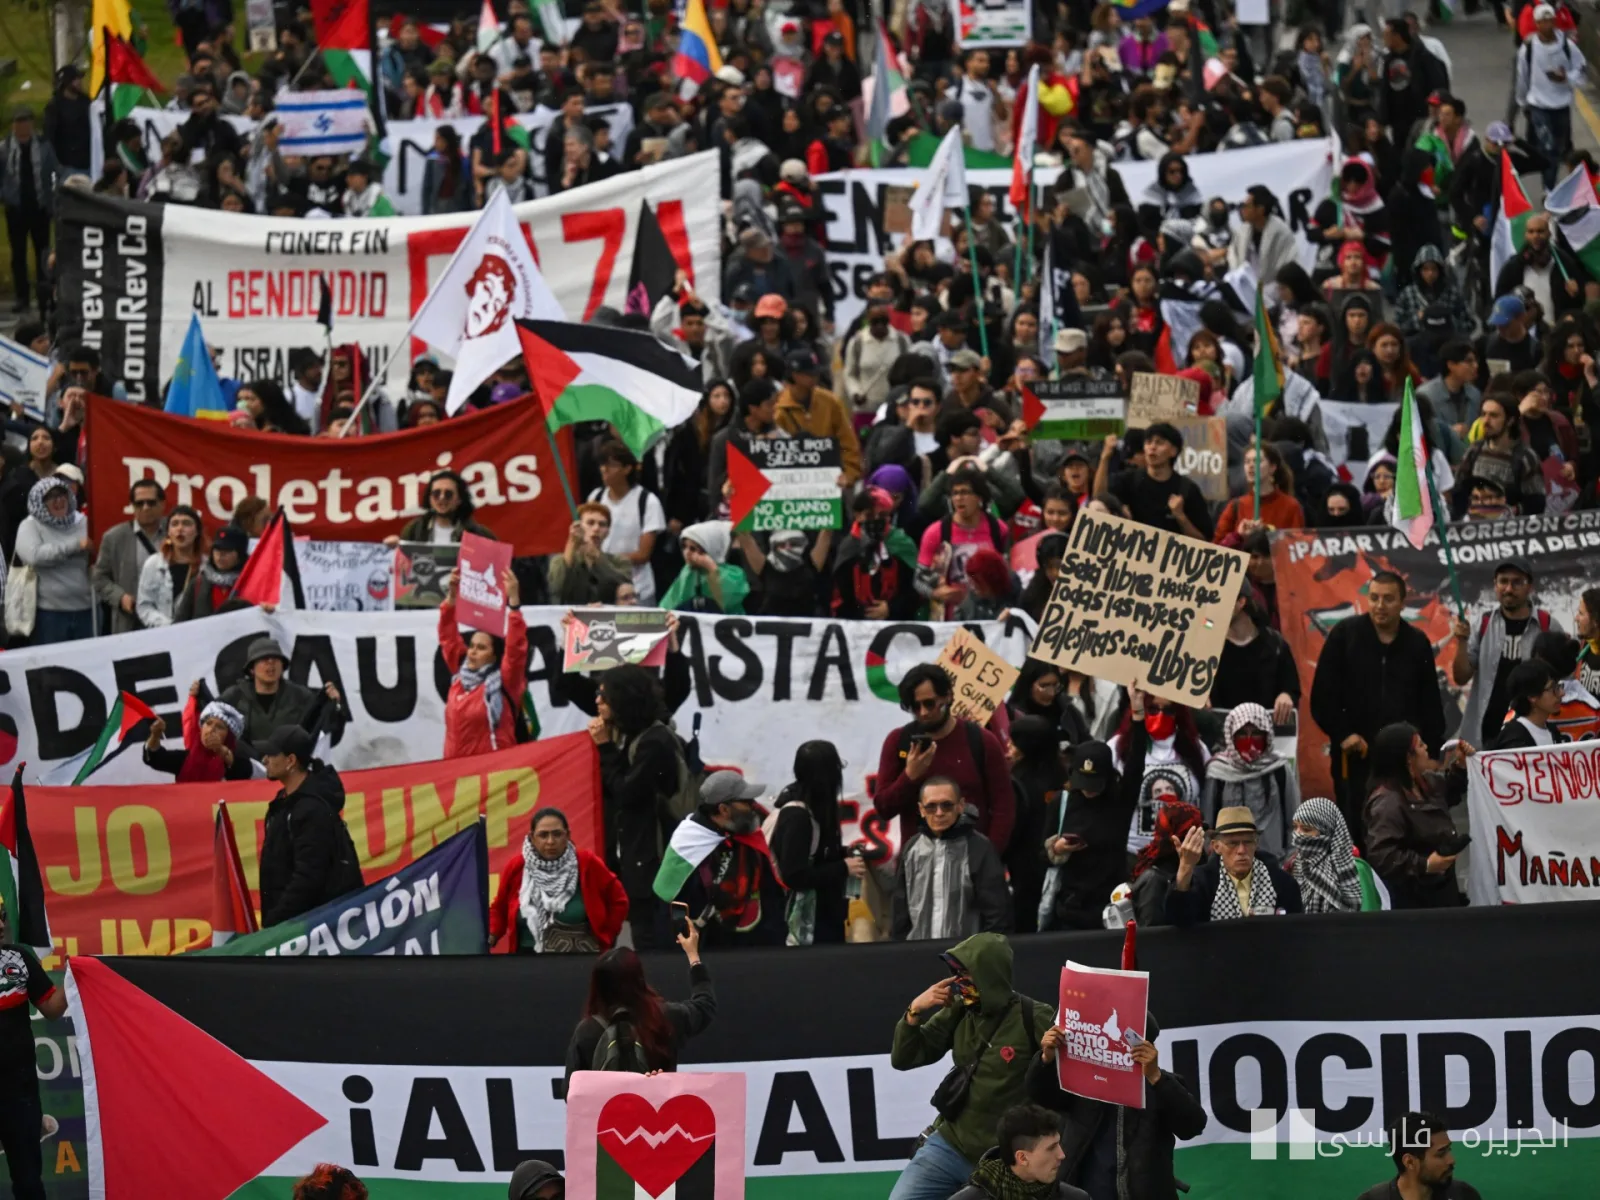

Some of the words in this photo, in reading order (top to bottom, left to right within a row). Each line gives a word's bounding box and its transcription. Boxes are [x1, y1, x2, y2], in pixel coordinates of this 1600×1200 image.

[349, 227, 389, 255] FIN
[82, 226, 104, 349] rev.co
[193, 280, 219, 317] AL
[774, 439, 801, 454] QUE
[122, 451, 542, 524] Proletarias
[753, 501, 775, 516] NO
[753, 514, 785, 531] LOS
[786, 513, 834, 530] MATAN
[1549, 533, 1577, 552] DE
[951, 645, 977, 670] NO
[976, 660, 1004, 688] ES
[212, 767, 541, 890] TUMP
[265, 872, 442, 956] PACIÓN
[1065, 1008, 1080, 1021] NO
[1065, 1019, 1101, 1035] SOMOS
[1065, 1029, 1109, 1050] PATIO
[1067, 1043, 1135, 1067] TRASERO
[753, 1067, 915, 1167] AL
[1171, 1026, 1600, 1134] OCIDIO
